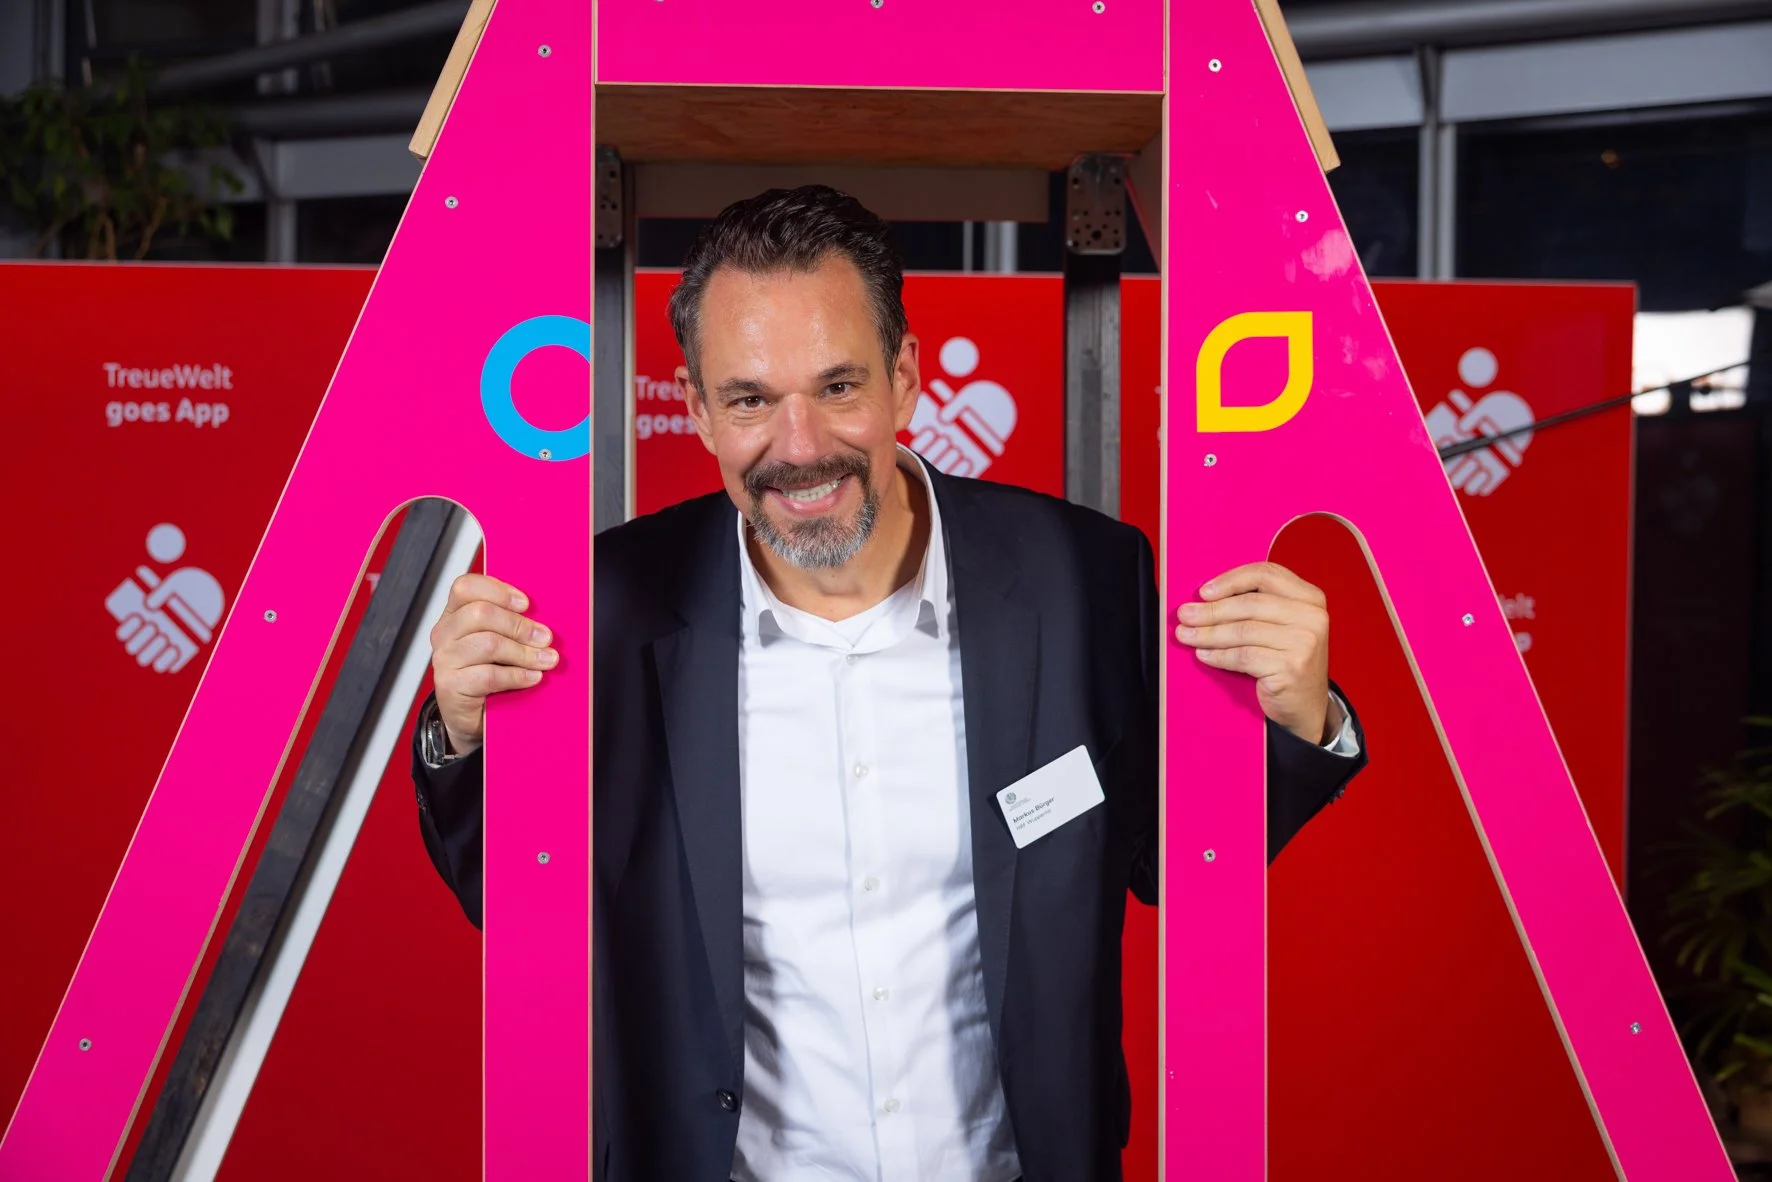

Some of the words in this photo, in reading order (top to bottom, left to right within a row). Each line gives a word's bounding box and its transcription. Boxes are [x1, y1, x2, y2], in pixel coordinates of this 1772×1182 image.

[103, 362, 233, 390] TreueWelt
[106, 401, 171, 427] goes
[175, 397, 230, 429] App
[1013, 809, 1034, 823] Markus
